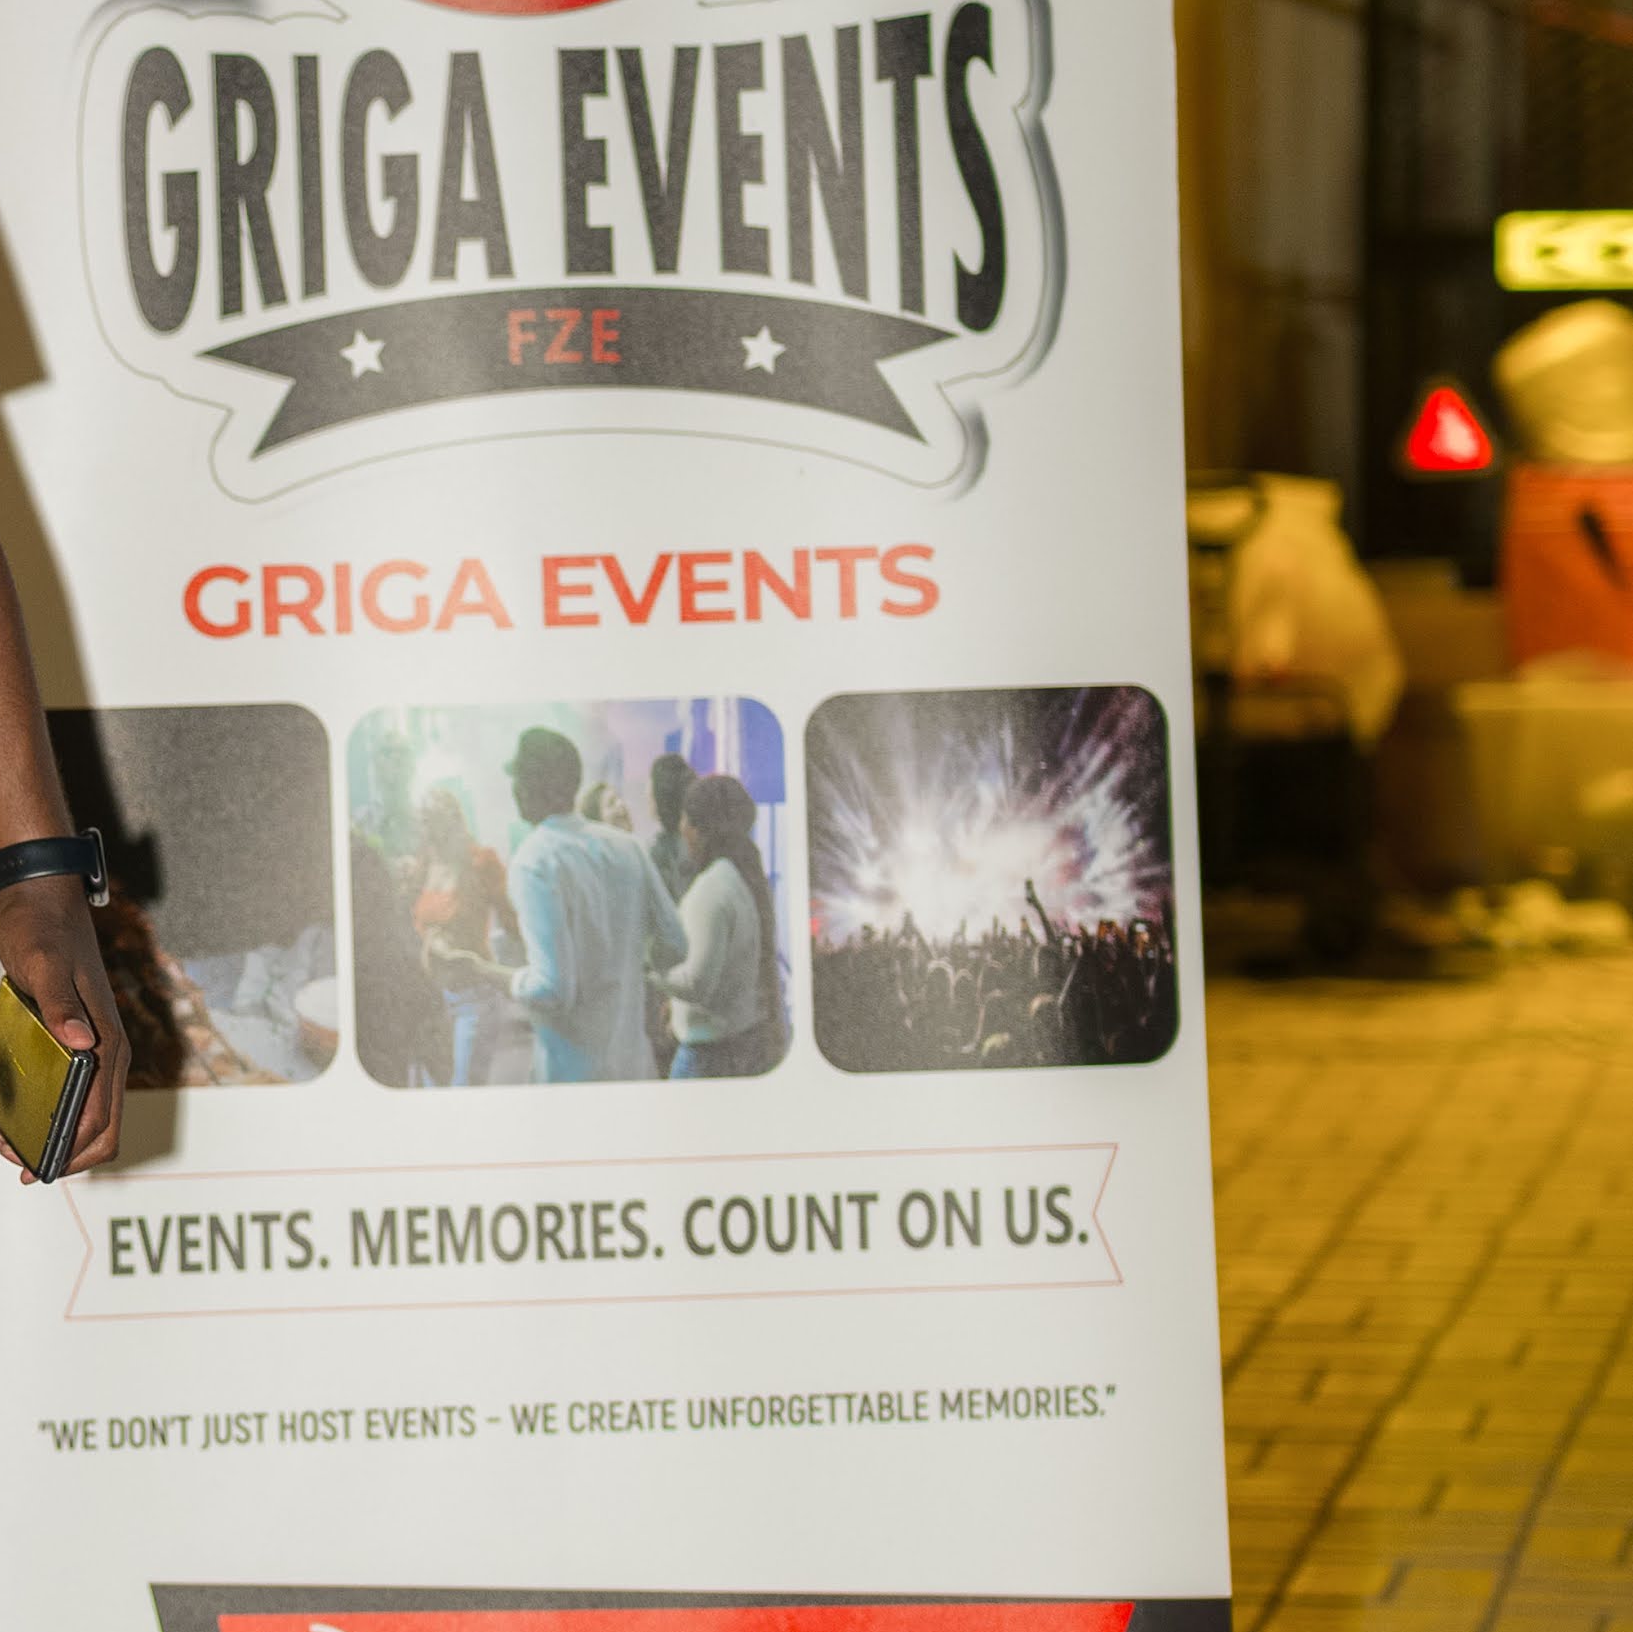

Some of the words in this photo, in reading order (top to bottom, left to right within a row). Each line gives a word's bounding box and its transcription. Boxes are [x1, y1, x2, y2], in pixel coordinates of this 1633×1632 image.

[119, 45, 514, 335] GRIGA
[556, 1, 1007, 335] EVENTS
[507, 307, 622, 367] FZE
[183, 557, 515, 638] GRIGA
[541, 543, 942, 628] EVENTS
[109, 1210, 331, 1276] EVENTS.
[350, 1200, 665, 1268] MEMORIES.
[683, 1191, 880, 1257] COUNT
[898, 1187, 983, 1250] ON
[1003, 1184, 1090, 1246] US.
[107, 1414, 192, 1450] DON'T
[200, 1412, 268, 1449] JUST
[278, 1408, 356, 1446] HOST
[366, 1405, 477, 1441] EVENTS
[509, 1402, 558, 1436] WE
[568, 1398, 677, 1435] CREATE
[686, 1391, 930, 1431] UNFORGETTABLE
